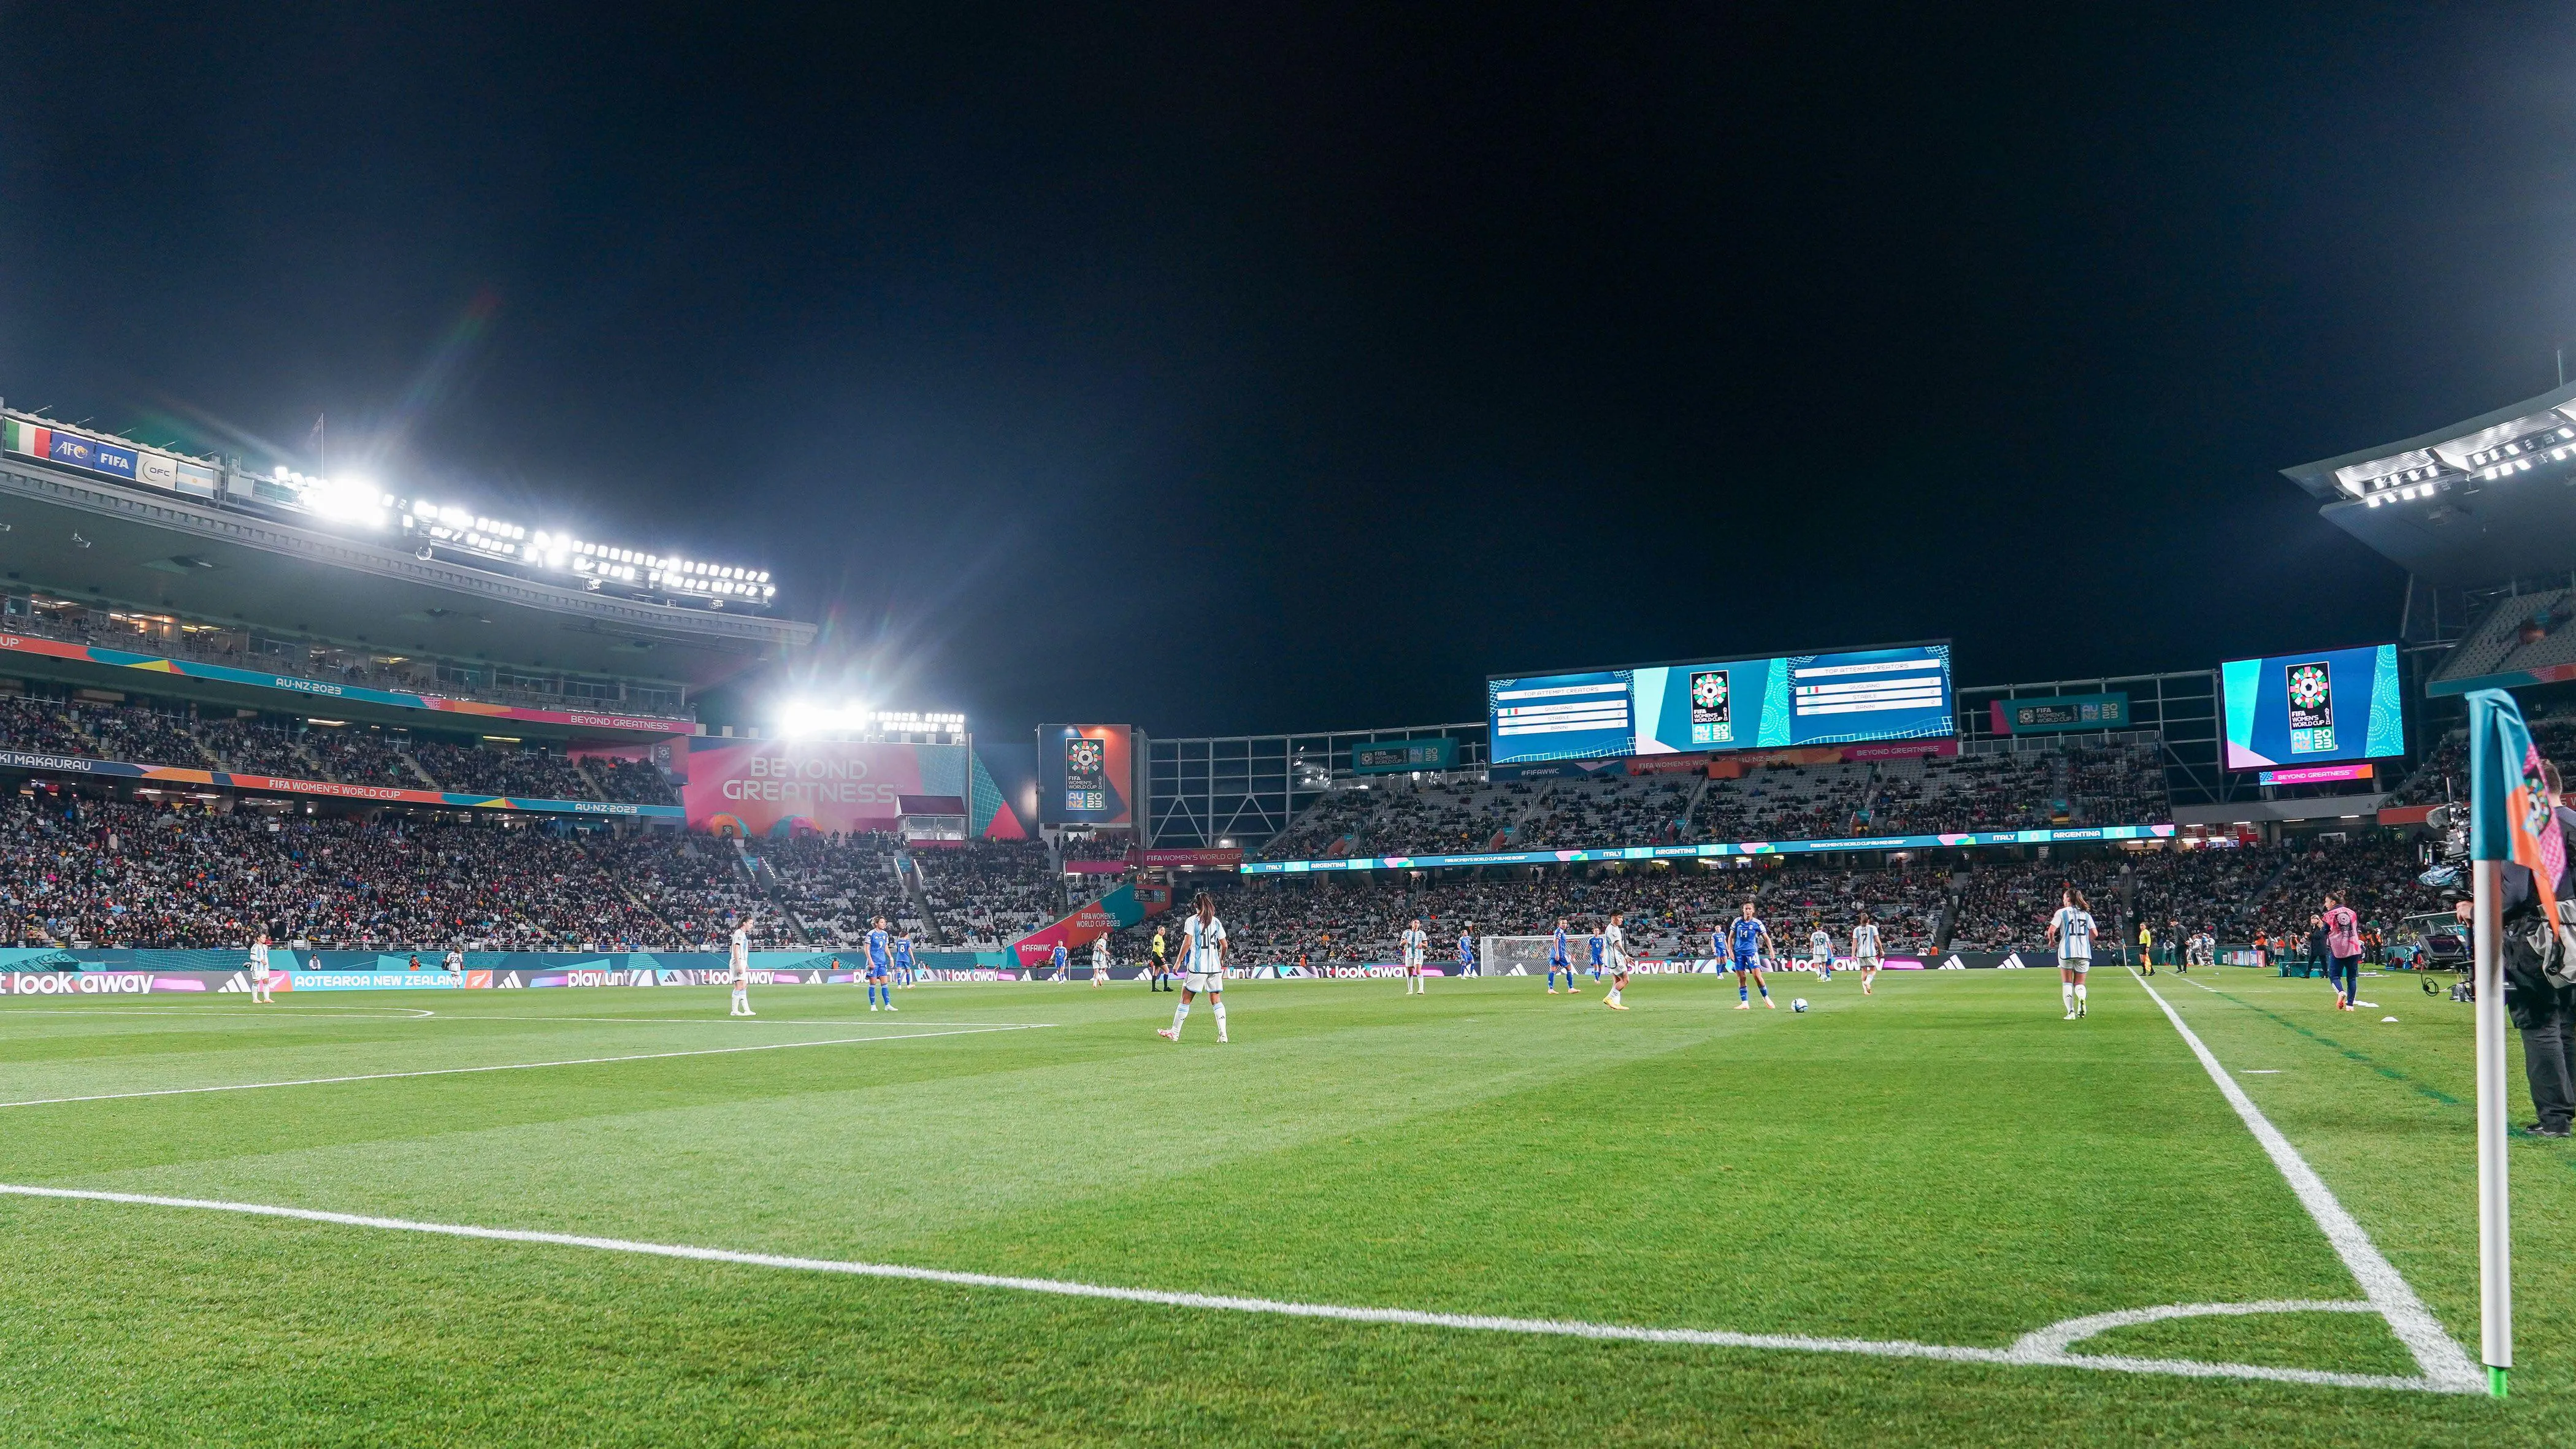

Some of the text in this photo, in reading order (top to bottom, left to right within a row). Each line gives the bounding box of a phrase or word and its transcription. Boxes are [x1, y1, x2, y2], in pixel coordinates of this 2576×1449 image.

[55, 441, 88, 459] AFC
[100, 453, 129, 470] FIFA
[150, 467, 171, 477] OFC
[571, 715, 669, 730] BEYOND GREATNESS
[2293, 728, 2331, 741] AU 20
[1857, 746, 1939, 756] BEYOND GREATNESS
[2294, 740, 2311, 750] NZ
[2314, 738, 2333, 749] 23
[15, 754, 91, 771] MAKAURAU
[751, 757, 868, 780] BEYOND
[2308, 770, 2350, 778] GREATNESS
[269, 779, 401, 798] FIFA WOMEN'S WORLD CUP
[723, 779, 895, 804] GREATNESS
[1200, 928, 1217, 949] 14
[1861, 933, 1868, 944] 7
[1335, 965, 1367, 978] look
[1833, 958, 1885, 971] awy
[294, 975, 370, 987] AOTEAROA
[373, 975, 402, 987] NEW
[567, 969, 602, 987] play
[952, 969, 972, 981] look
[973, 971, 999, 981] away
[13, 971, 74, 995] look
[79, 974, 154, 994] away
